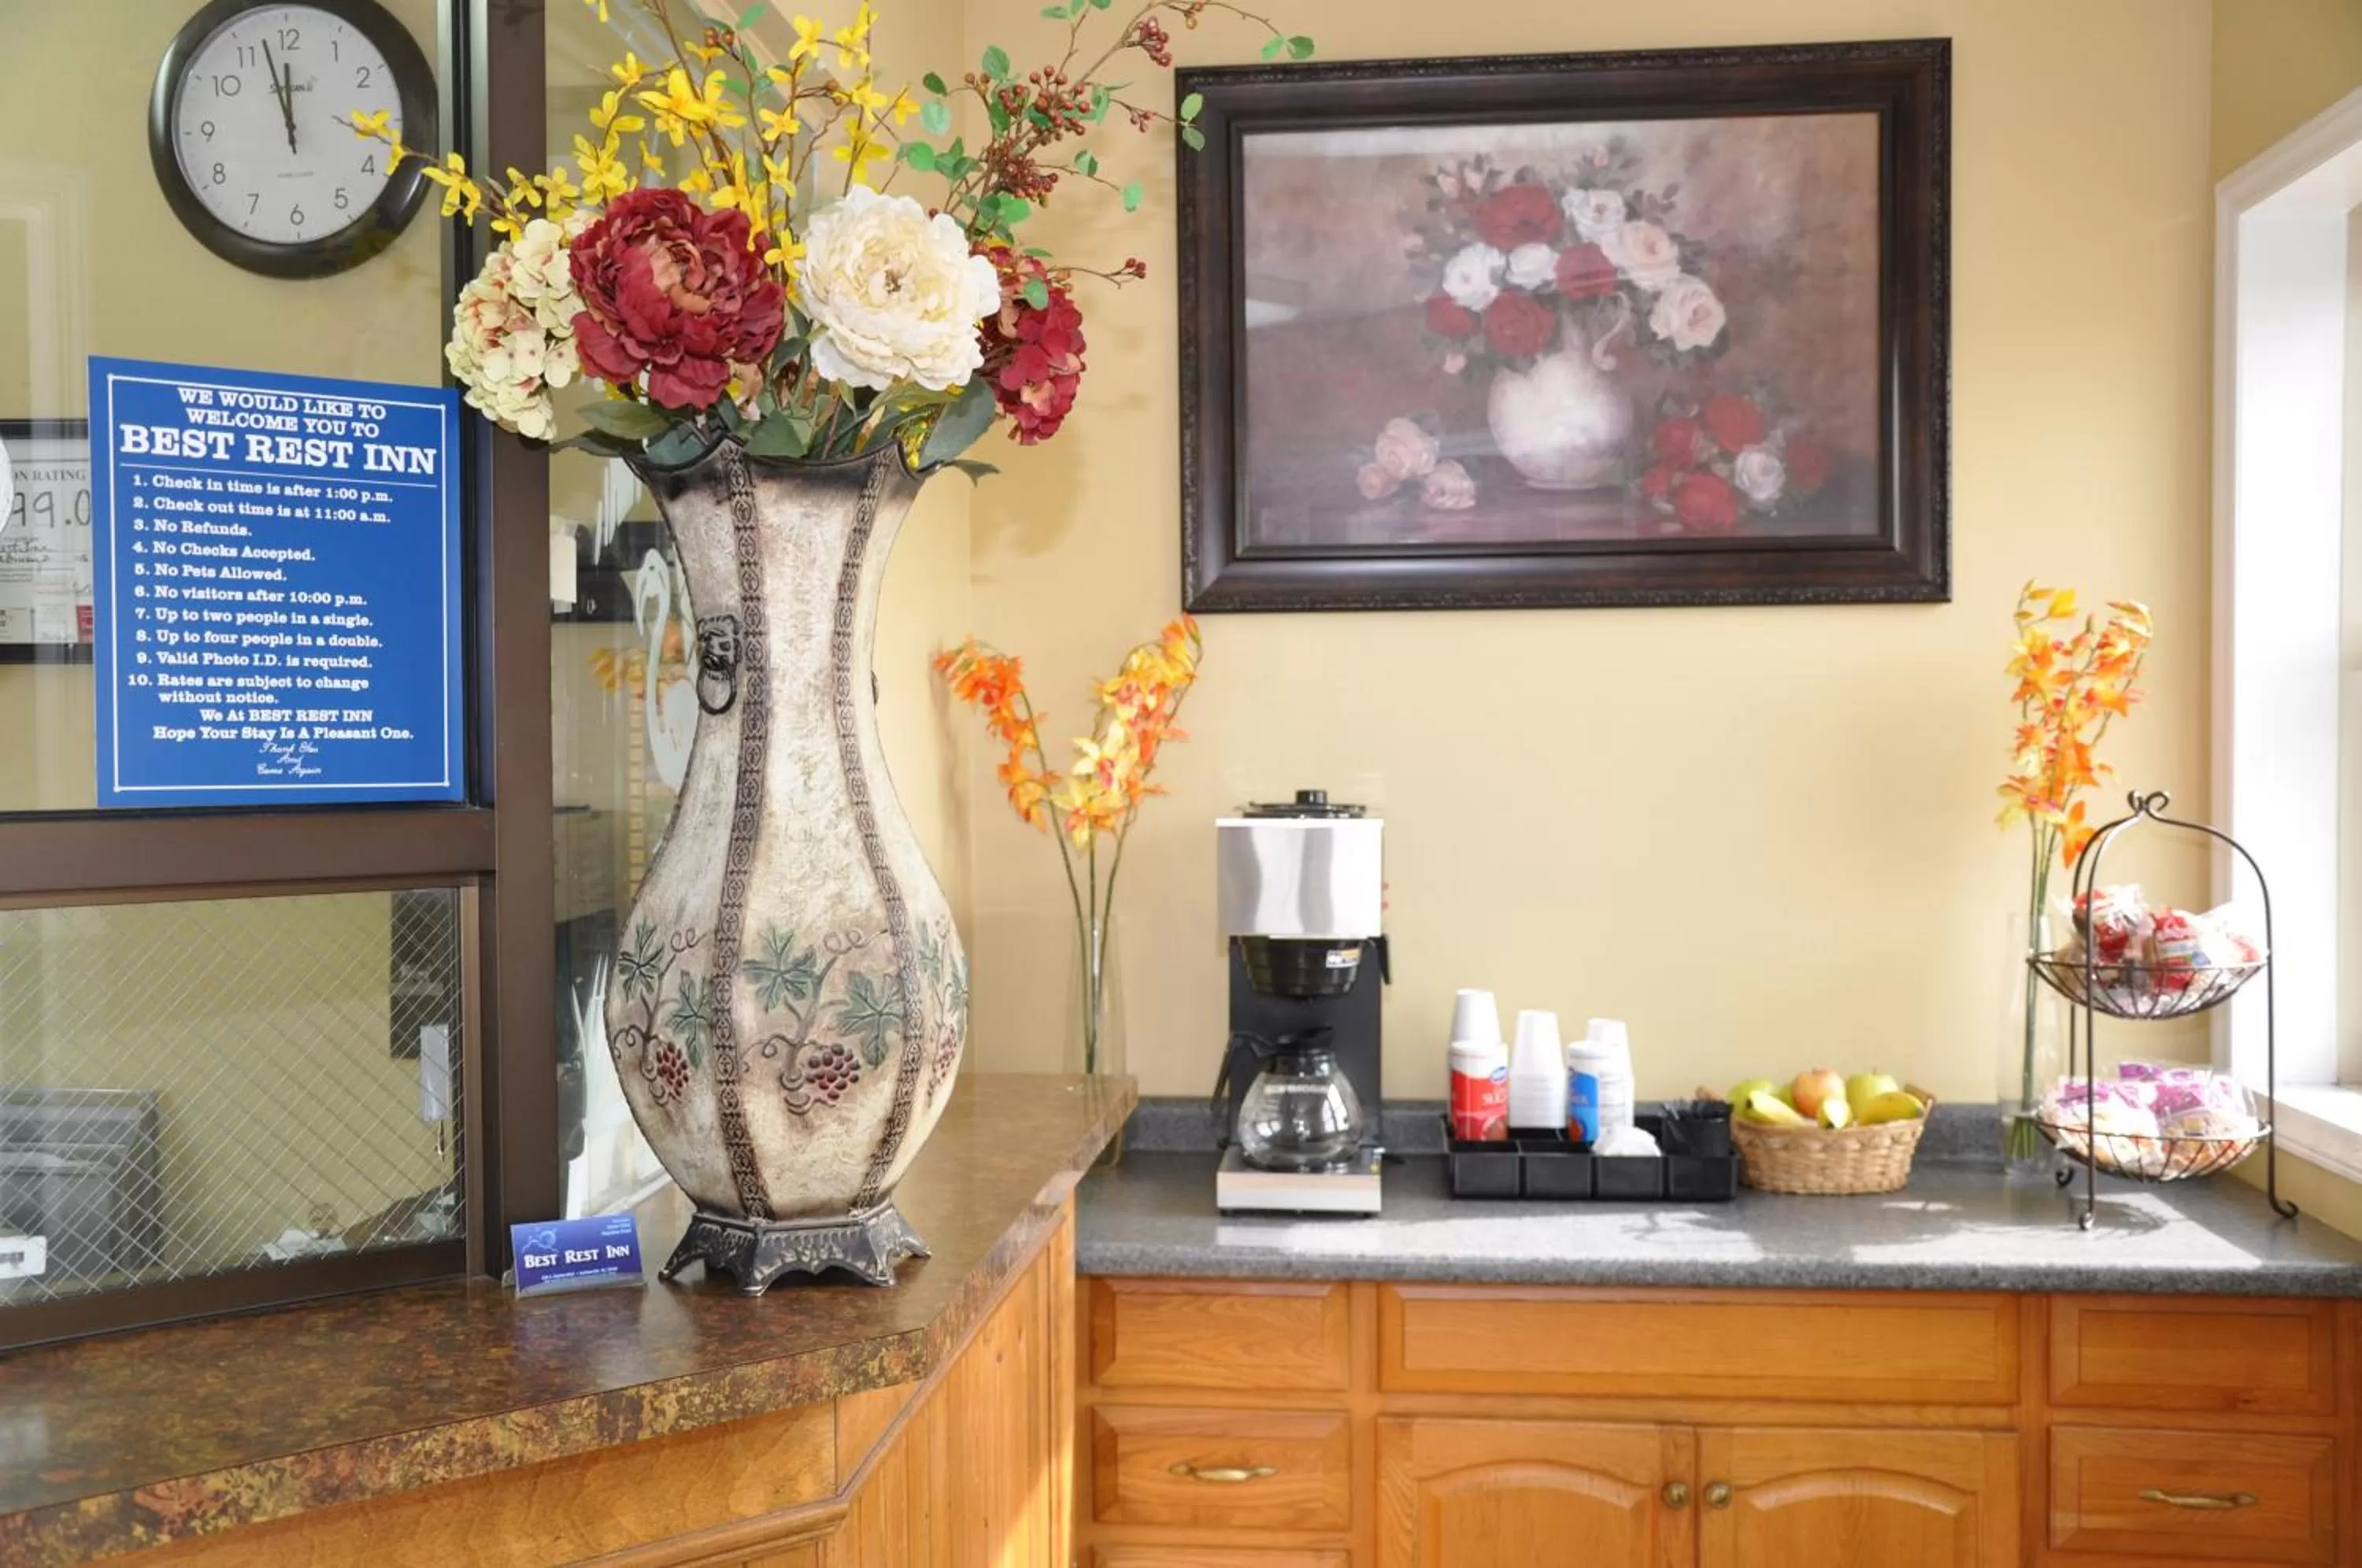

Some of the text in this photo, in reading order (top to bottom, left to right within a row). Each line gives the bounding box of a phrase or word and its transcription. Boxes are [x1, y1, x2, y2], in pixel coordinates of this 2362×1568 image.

[276, 28, 301, 51] 12
[236, 46, 256, 68] 11
[331, 41, 339, 62] 1
[213, 75, 242, 97] 10
[356, 66, 371, 88] 2
[201, 120, 215, 142] 9
[213, 162, 226, 184] 8
[361, 154, 375, 176] 4
[247, 194, 260, 215] 7
[334, 188, 349, 209] 5
[290, 204, 305, 226] 6
[178, 387, 386, 420] WE WOULD LIKE TO
[186, 408, 379, 438] WELCOME YOU TO
[120, 424, 436, 474] BEST REST INN
[135, 475, 392, 503] 1. Check in time is after 1:00 p.m.
[134, 497, 391, 522] 2. Check out time is at 11:00 a.m.
[134, 519, 252, 535] 3. No Refunds.
[133, 542, 315, 562] 4. No Checks Accepted.
[135, 564, 287, 580] 5. No Pets Allowed.
[135, 586, 366, 606] 6. No visitors after 10:00 p.m.
[135, 608, 372, 628] 7. Up to two people in a single.
[136, 630, 382, 647] 8. Up to four people in a double.
[137, 652, 372, 670] 9. Valid Photo I.D. is required.
[128, 674, 368, 691] 10. Rates are subject to change
[159, 691, 278, 703] without notice.
[200, 709, 372, 722] We At BEST REST INN
[154, 727, 413, 741] Hope Your Stay Is A Pleasant One.
